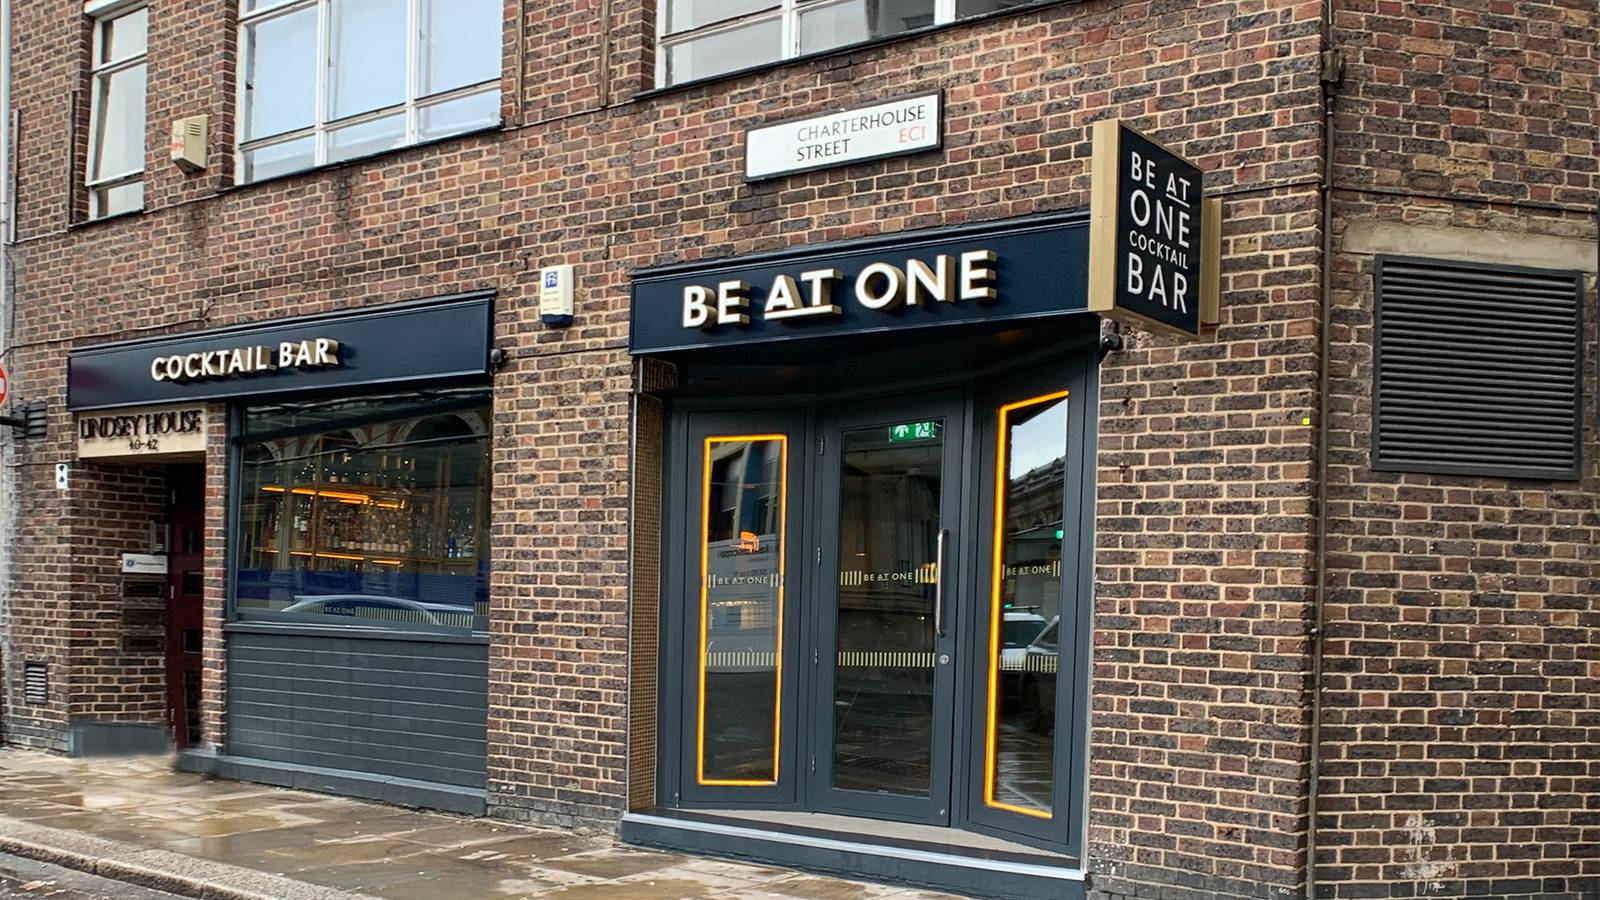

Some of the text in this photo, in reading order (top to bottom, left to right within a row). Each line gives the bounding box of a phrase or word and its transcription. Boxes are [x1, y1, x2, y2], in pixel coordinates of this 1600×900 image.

[797, 105, 926, 142] CHARTERHOUSE
[797, 139, 850, 162] STREET
[1131, 151, 1190, 208] BE AT
[1130, 189, 1190, 249] ONE
[1129, 230, 1189, 270] COCKTAIL
[683, 250, 994, 328] BE AT ONE
[1128, 252, 1188, 314] BAR
[151, 338, 335, 381] COCKTAIL BAR
[80, 409, 203, 439] LINDSEY HOUSE
[129, 439, 159, 450] 40-42
[718, 576, 769, 585] BE AT ONE
[863, 572, 913, 582] BE AT ONE
[1006, 565, 1052, 576] BE AT ONE
